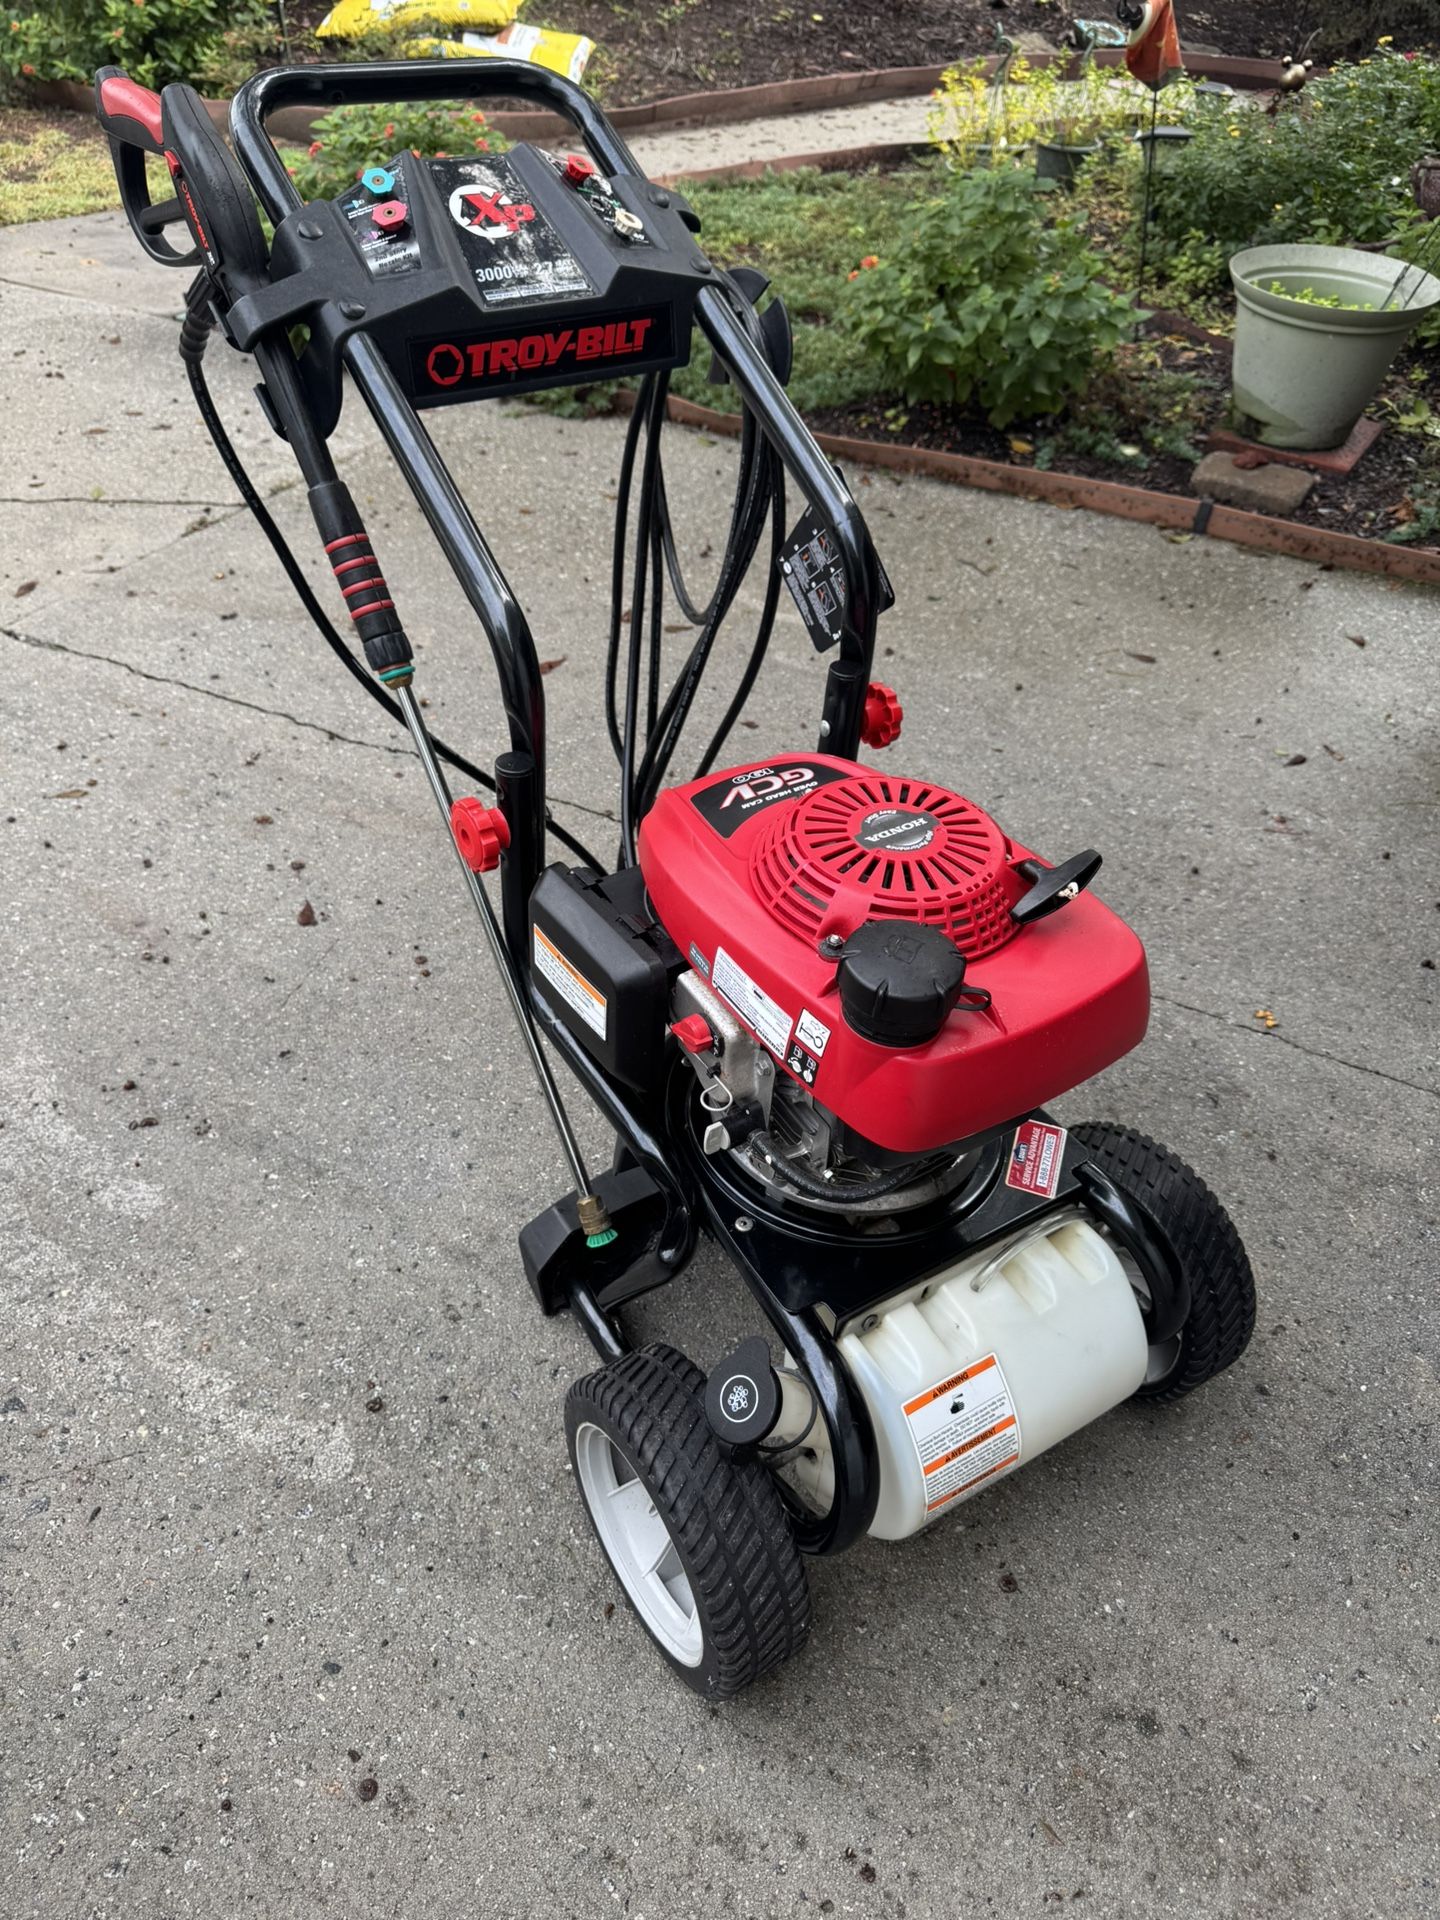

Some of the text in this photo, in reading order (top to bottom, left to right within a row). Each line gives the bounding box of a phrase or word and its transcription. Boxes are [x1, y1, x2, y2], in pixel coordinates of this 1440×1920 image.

[475, 265, 512, 283] 3000
[467, 318, 652, 377] TROY-BILT
[720, 767, 814, 810] GCV
[741, 781, 818, 809] OVER HEAD CAM
[864, 818, 928, 842] HONDA
[1022, 1161, 1033, 1185] SERVICE
[1028, 1127, 1041, 1161] ADVANTAGE
[1039, 1135, 1055, 1185] 1-888-77LOWES
[937, 1371, 969, 1393] WARNING
[951, 1427, 996, 1458] AVERTISSEMENT
